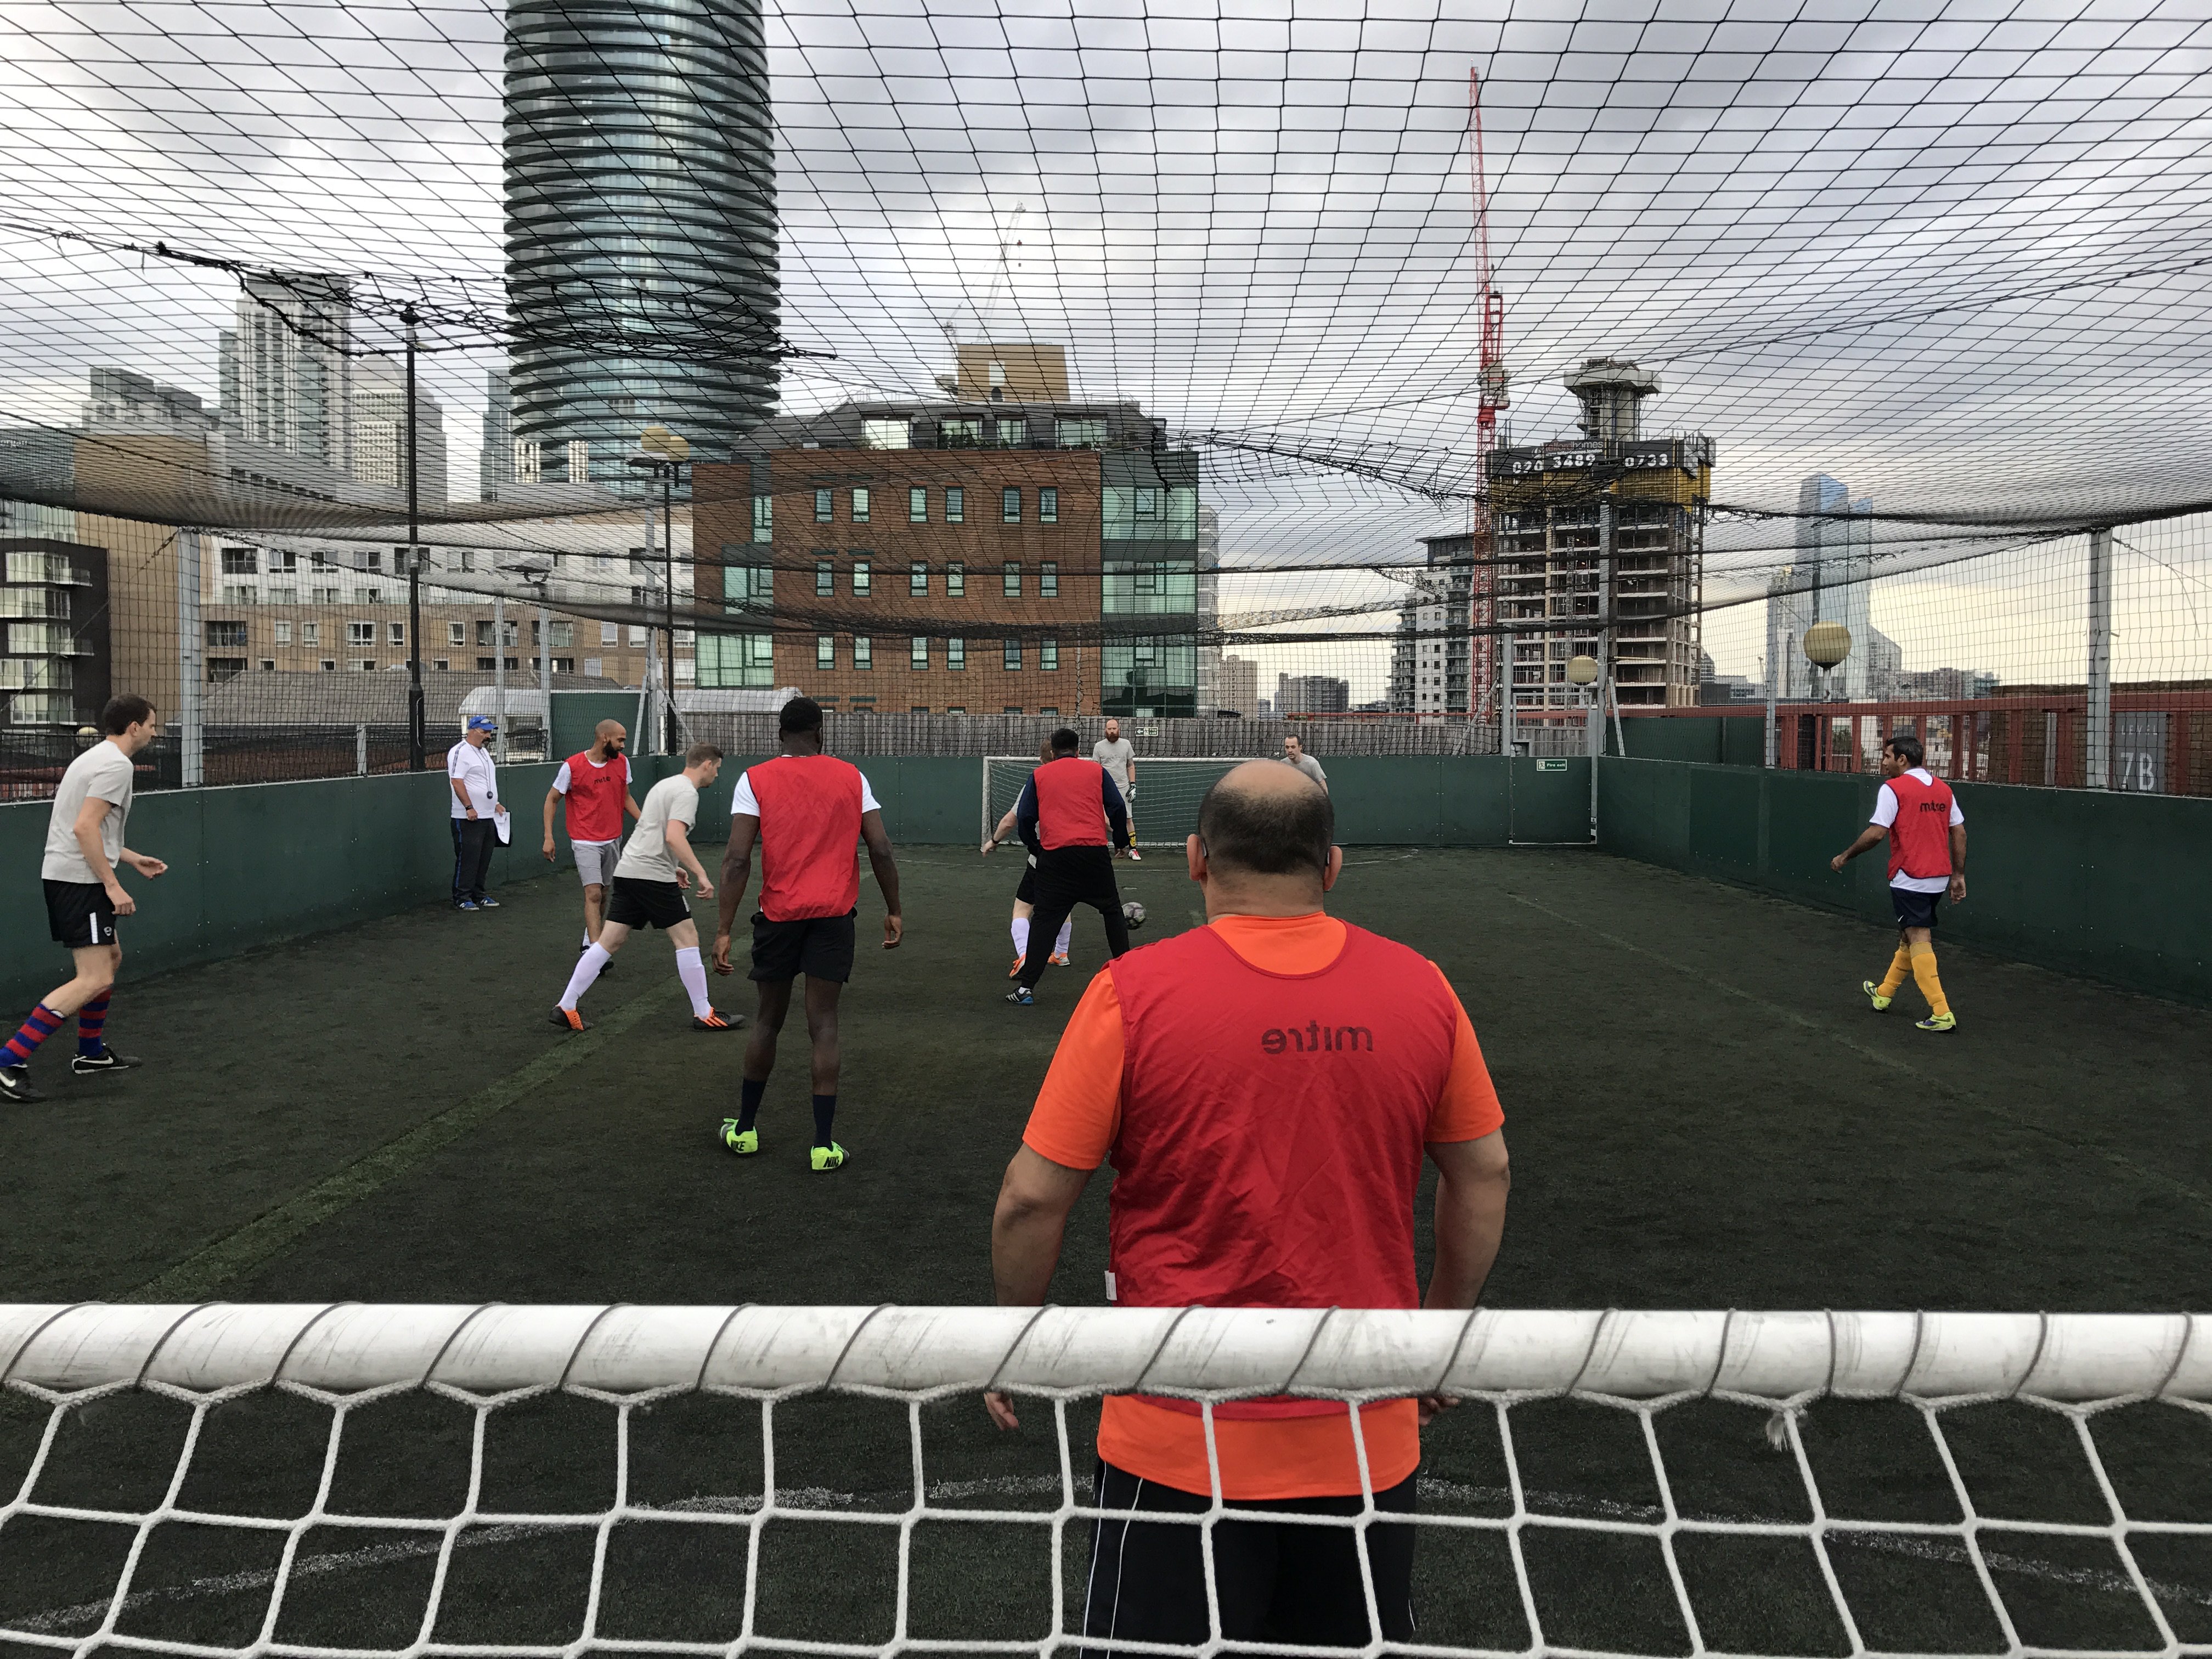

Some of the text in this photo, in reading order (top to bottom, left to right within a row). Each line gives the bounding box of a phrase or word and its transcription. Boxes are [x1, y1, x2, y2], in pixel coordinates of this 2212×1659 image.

[1512, 453, 1668, 474] 020 3489 0733
[2121, 724, 2158, 736] LEVEL
[2120, 752, 2154, 791] 7B
